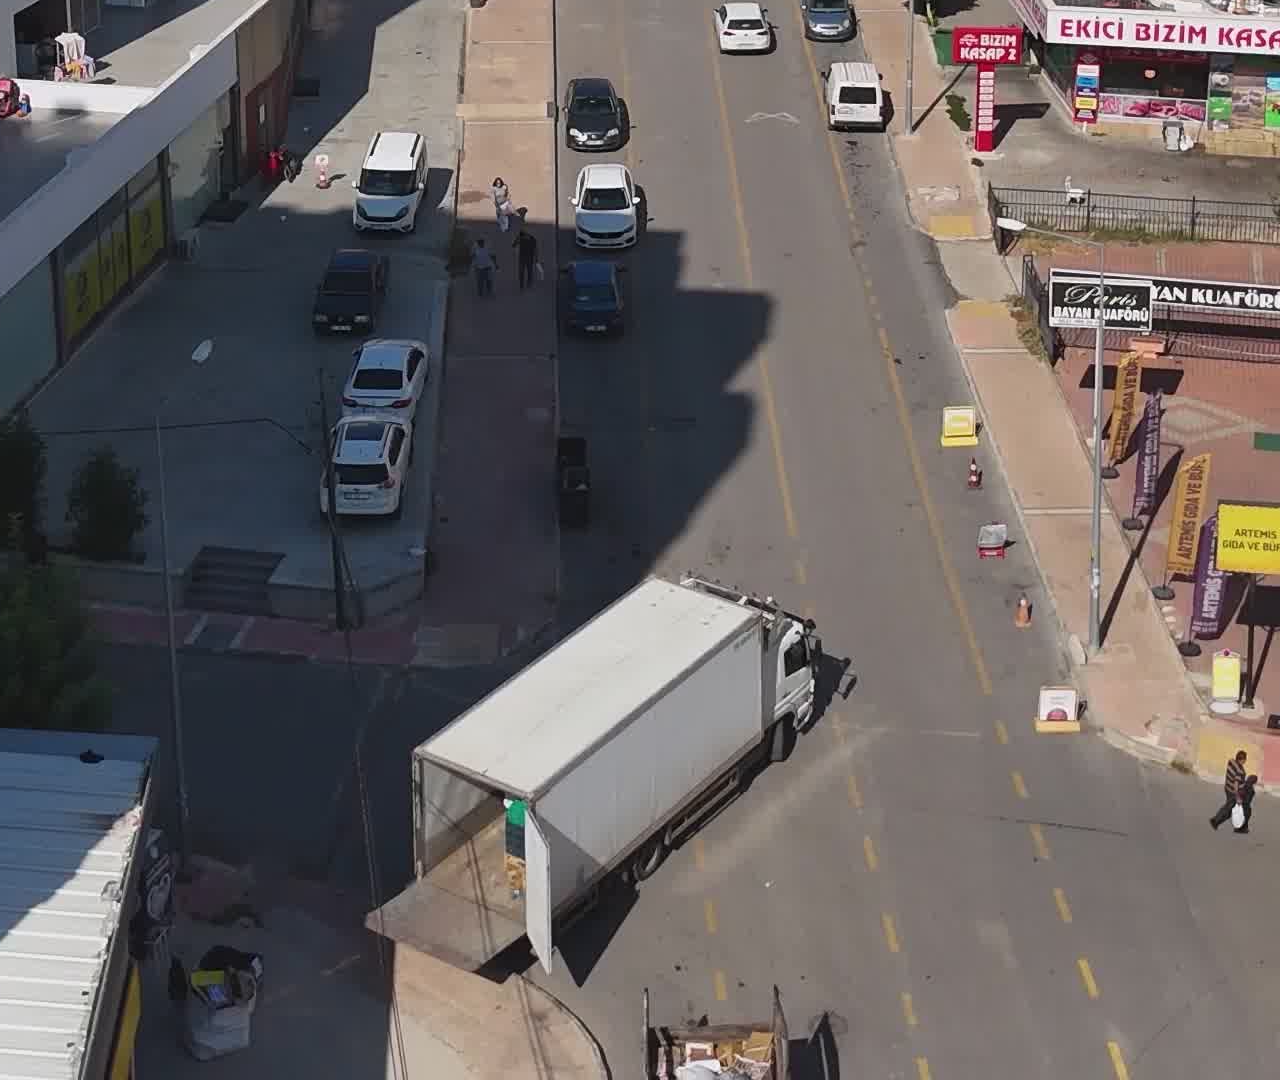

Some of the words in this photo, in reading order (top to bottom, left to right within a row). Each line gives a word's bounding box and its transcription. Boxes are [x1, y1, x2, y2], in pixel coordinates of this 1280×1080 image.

[1060, 16, 1123, 40] EKİCİ
[1135, 19, 1207, 44] BİZİM
[960, 47, 1005, 60] KASAP
[1008, 48, 1017, 60] 2
[1064, 285, 1137, 306] Paris
[1054, 306, 1092, 319] BAYAN
[1187, 482, 1202, 496] VE
[1222, 540, 1245, 550] GIDA
[1247, 541, 1261, 551] VE
